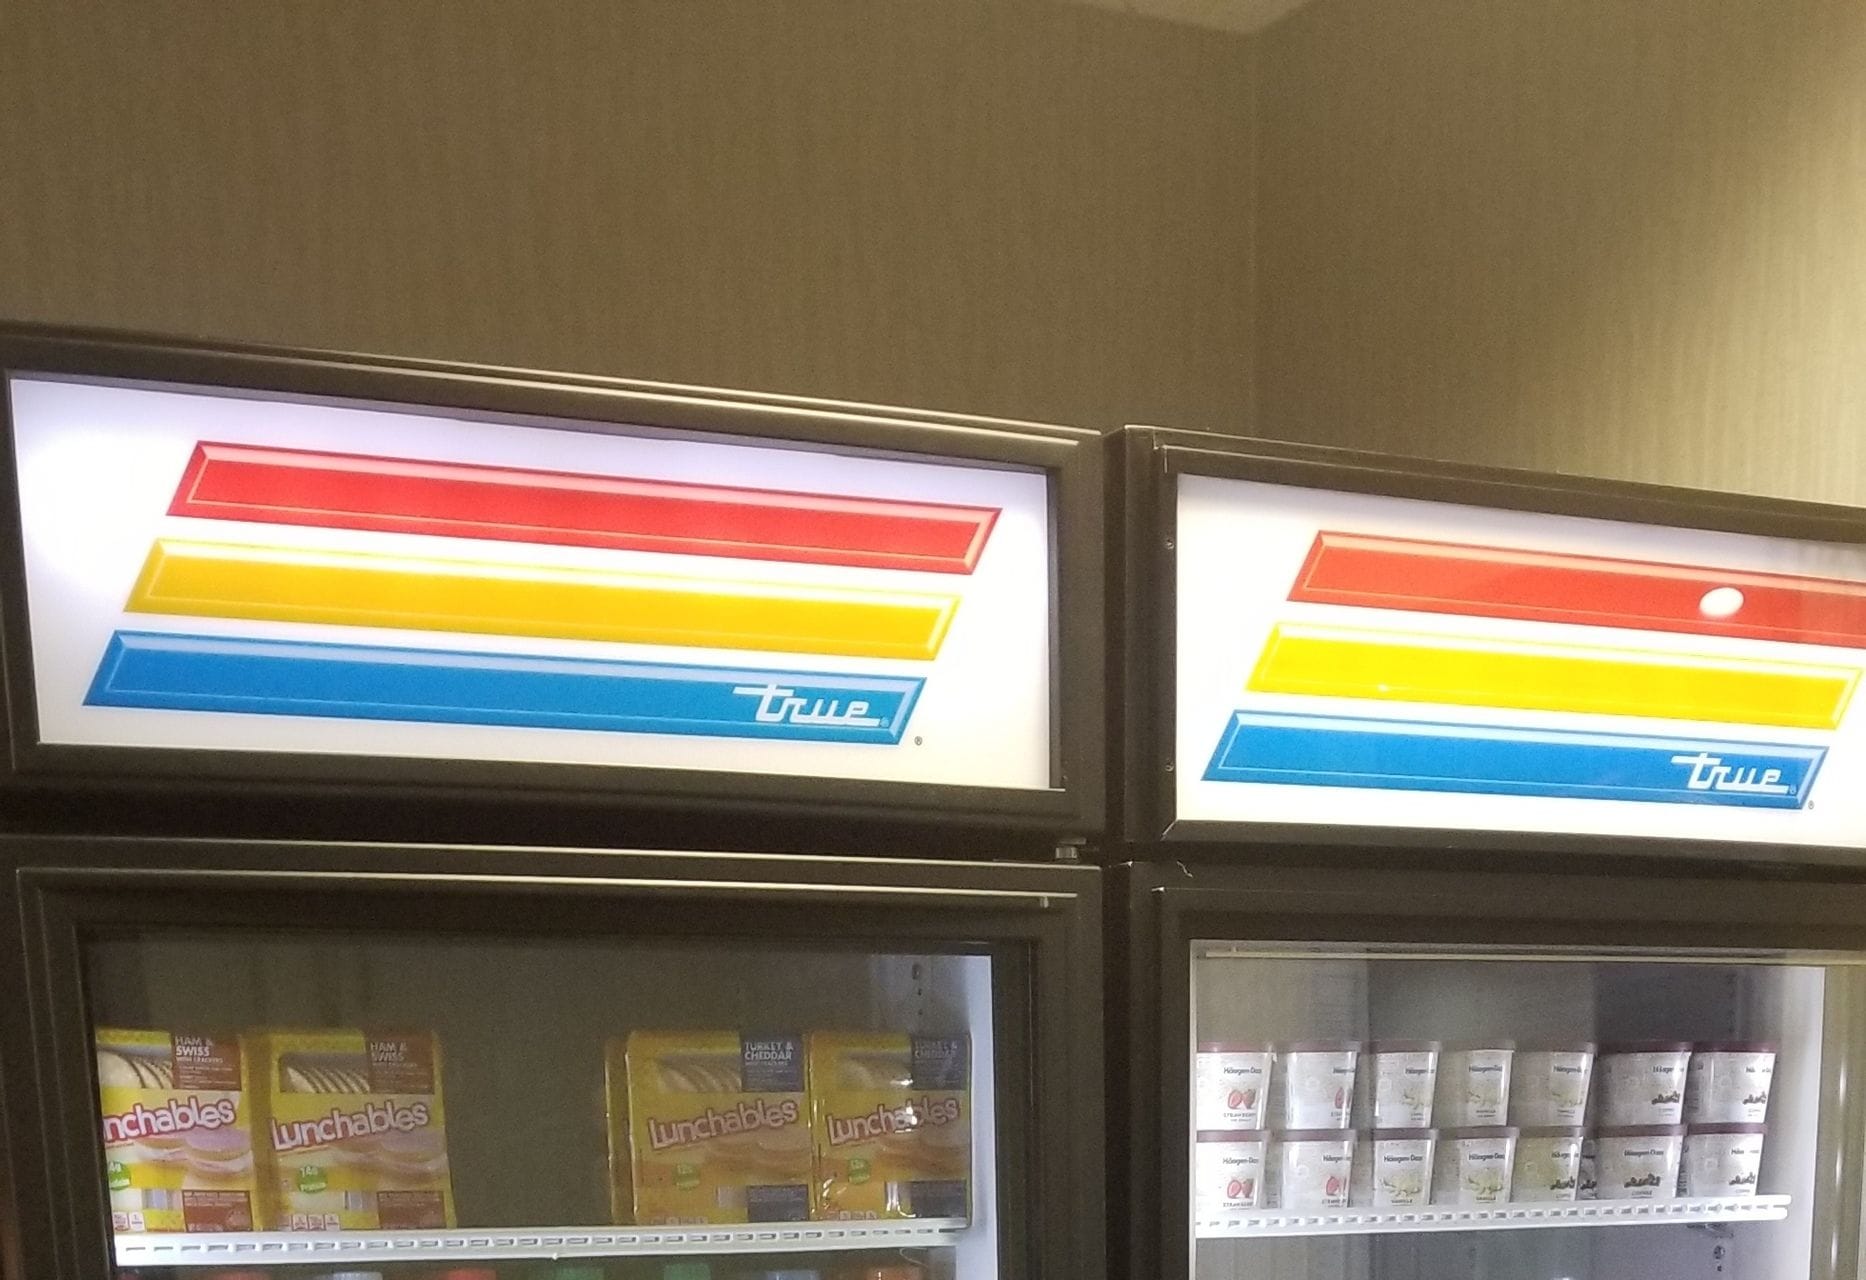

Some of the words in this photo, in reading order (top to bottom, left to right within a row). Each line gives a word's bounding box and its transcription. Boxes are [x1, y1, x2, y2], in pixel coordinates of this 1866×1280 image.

[732, 684, 881, 727] true
[1671, 752, 1789, 794] true
[176, 1045, 209, 1057] SWISS
[745, 1051, 792, 1060] CHEDDAR
[103, 1096, 236, 1142] nchables
[271, 1101, 429, 1151] Lunchables
[649, 1099, 798, 1149] Lunchables
[826, 1096, 960, 1146] Lunchables
